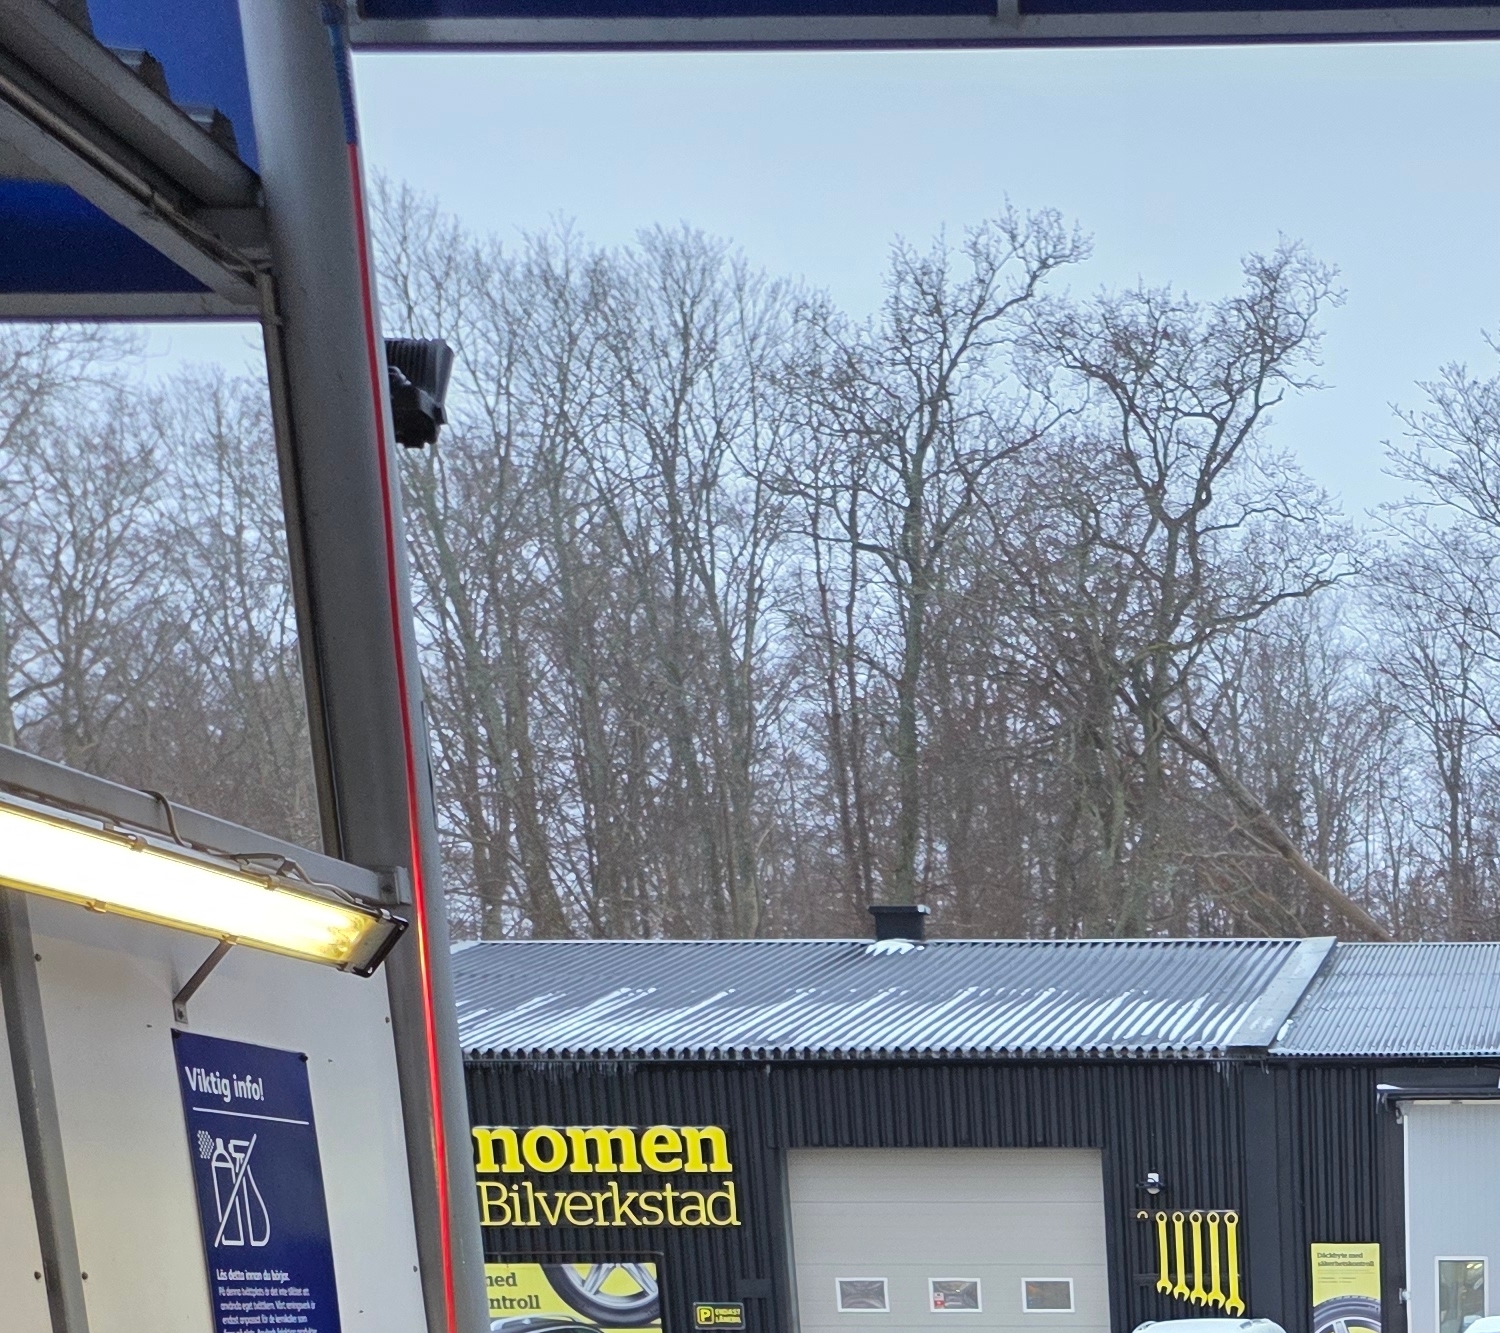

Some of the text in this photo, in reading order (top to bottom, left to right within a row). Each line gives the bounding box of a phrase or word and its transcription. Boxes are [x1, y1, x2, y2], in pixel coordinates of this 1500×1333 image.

[185, 1066, 264, 1103] Viktig info!
[472, 1125, 733, 1173] nomen
[476, 1181, 741, 1227] Bilverkstad
